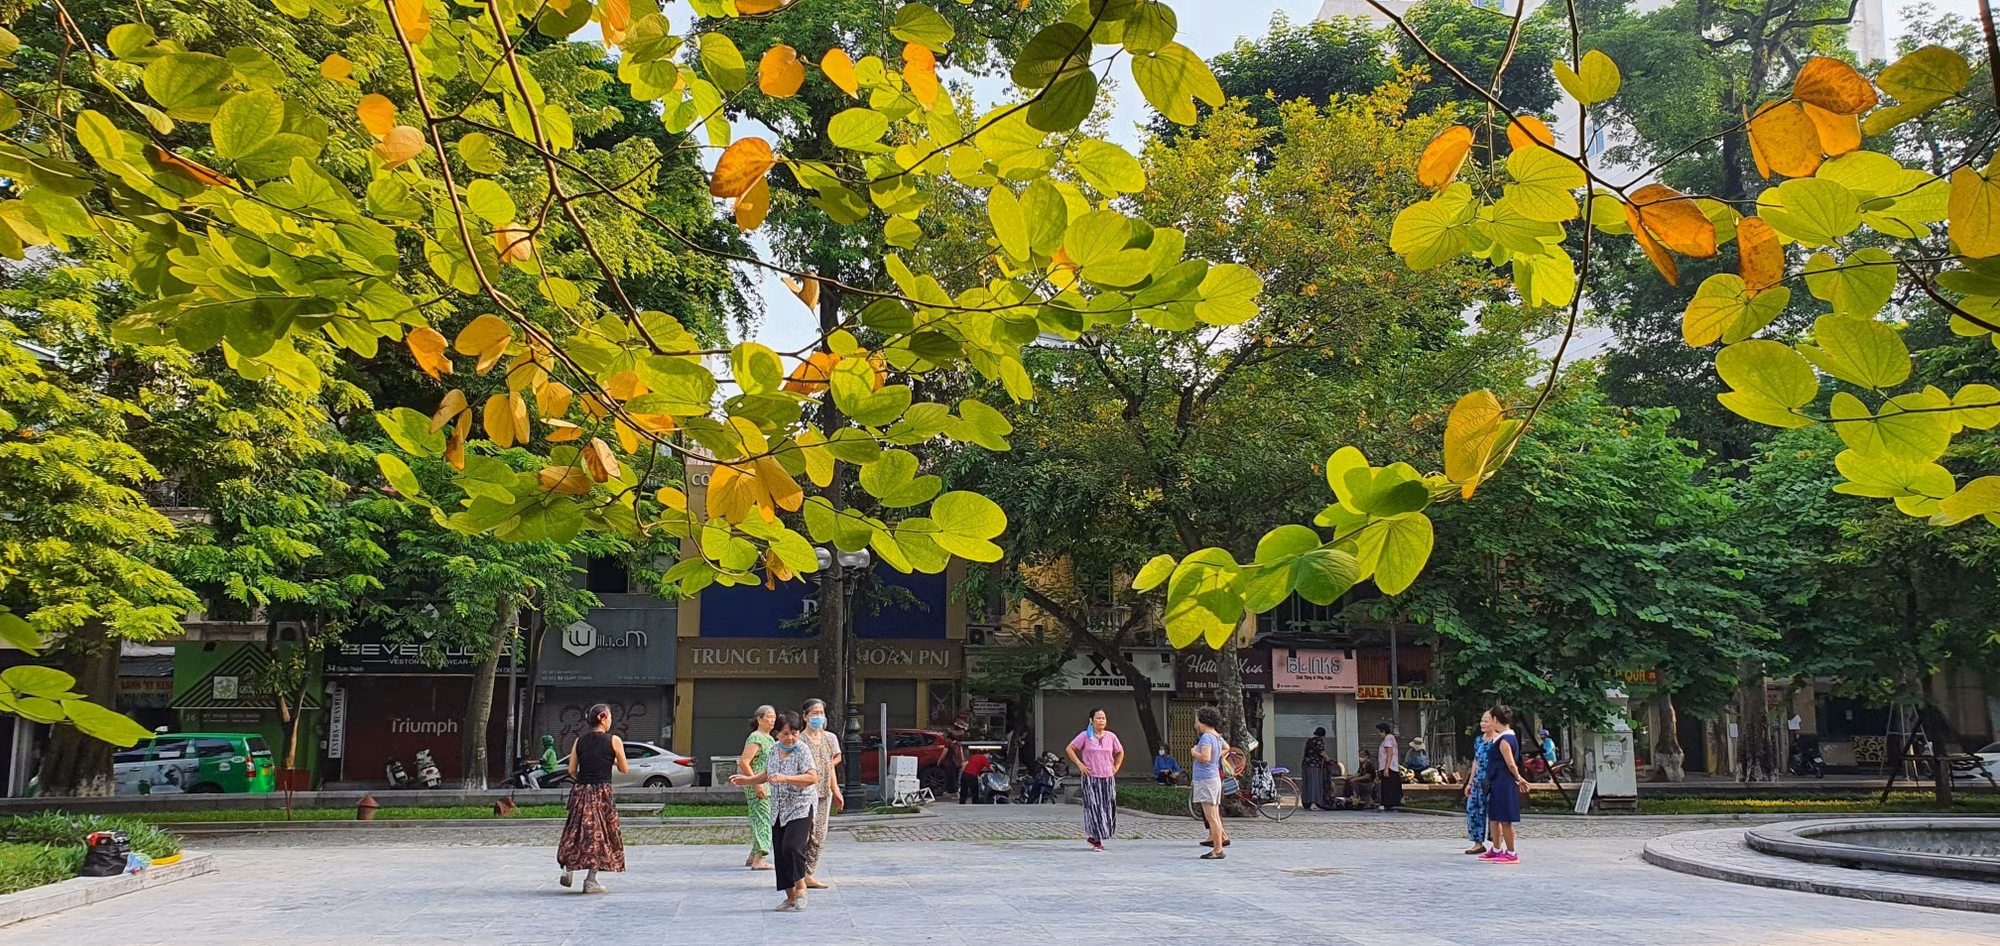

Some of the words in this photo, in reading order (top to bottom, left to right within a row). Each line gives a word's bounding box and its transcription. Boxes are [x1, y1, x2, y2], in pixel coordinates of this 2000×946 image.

[690, 647, 761, 664] TRUNG
[766, 644, 808, 664] TÂM
[919, 649, 949, 668] PNJ
[1358, 687, 1384, 698] SALE
[391, 718, 458, 736] Triumph
